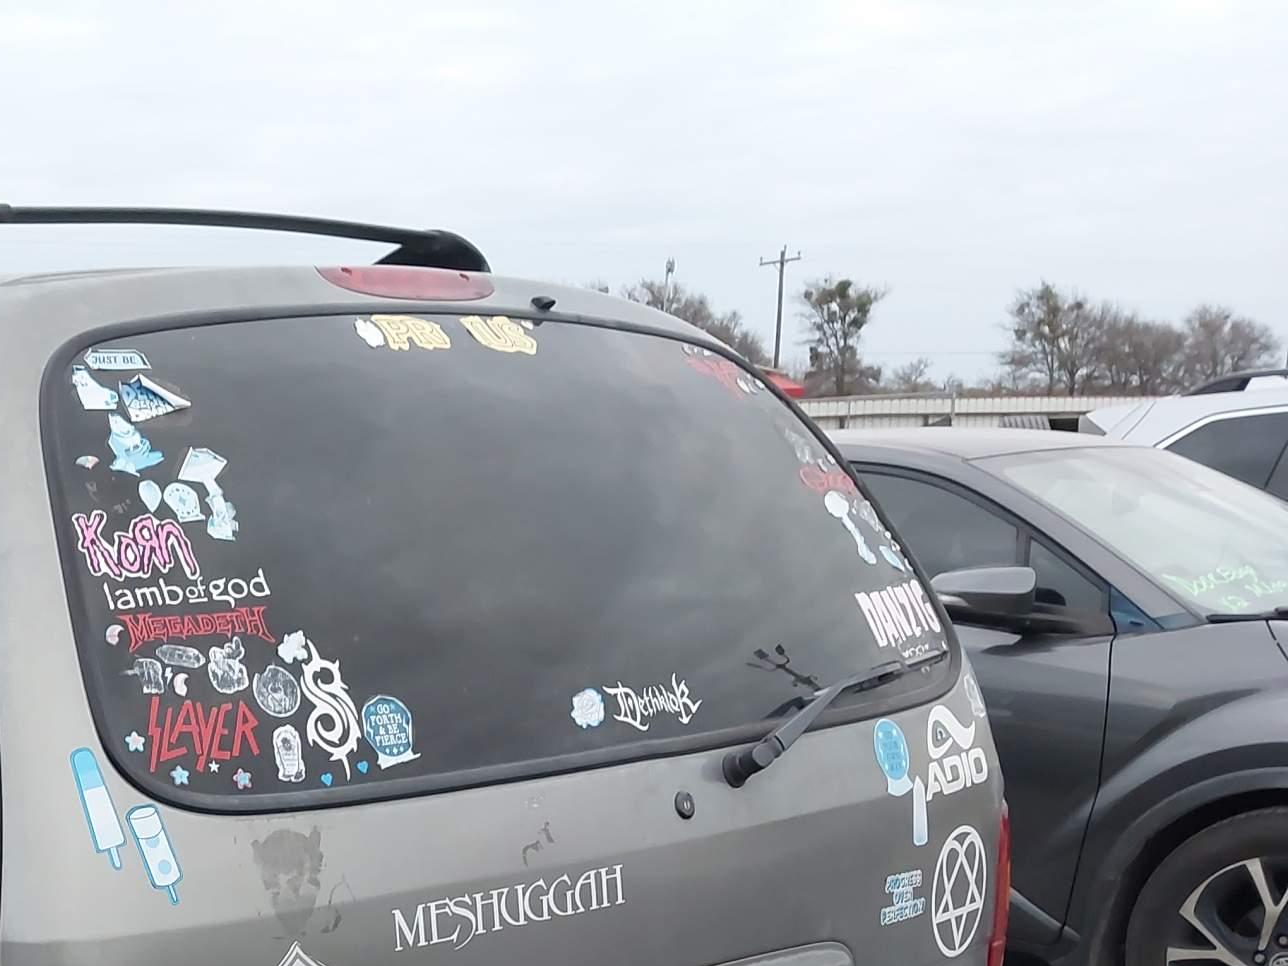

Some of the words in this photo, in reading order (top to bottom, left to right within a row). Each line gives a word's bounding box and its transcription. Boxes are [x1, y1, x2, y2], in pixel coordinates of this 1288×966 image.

[92, 354, 118, 364] JUST
[104, 578, 184, 611] lamb
[186, 577, 209, 604] of
[209, 567, 272, 609] god
[116, 605, 277, 653] MEGADETH
[854, 579, 941, 648] DANZIG
[369, 712, 402, 726] FORTH
[376, 703, 390, 714] GO
[387, 723, 400, 734] BE
[148, 694, 261, 773] SLAYER
[374, 732, 408, 747] FIERCE
[926, 747, 988, 802] ADIO
[391, 864, 626, 951] MESHUGGAH
